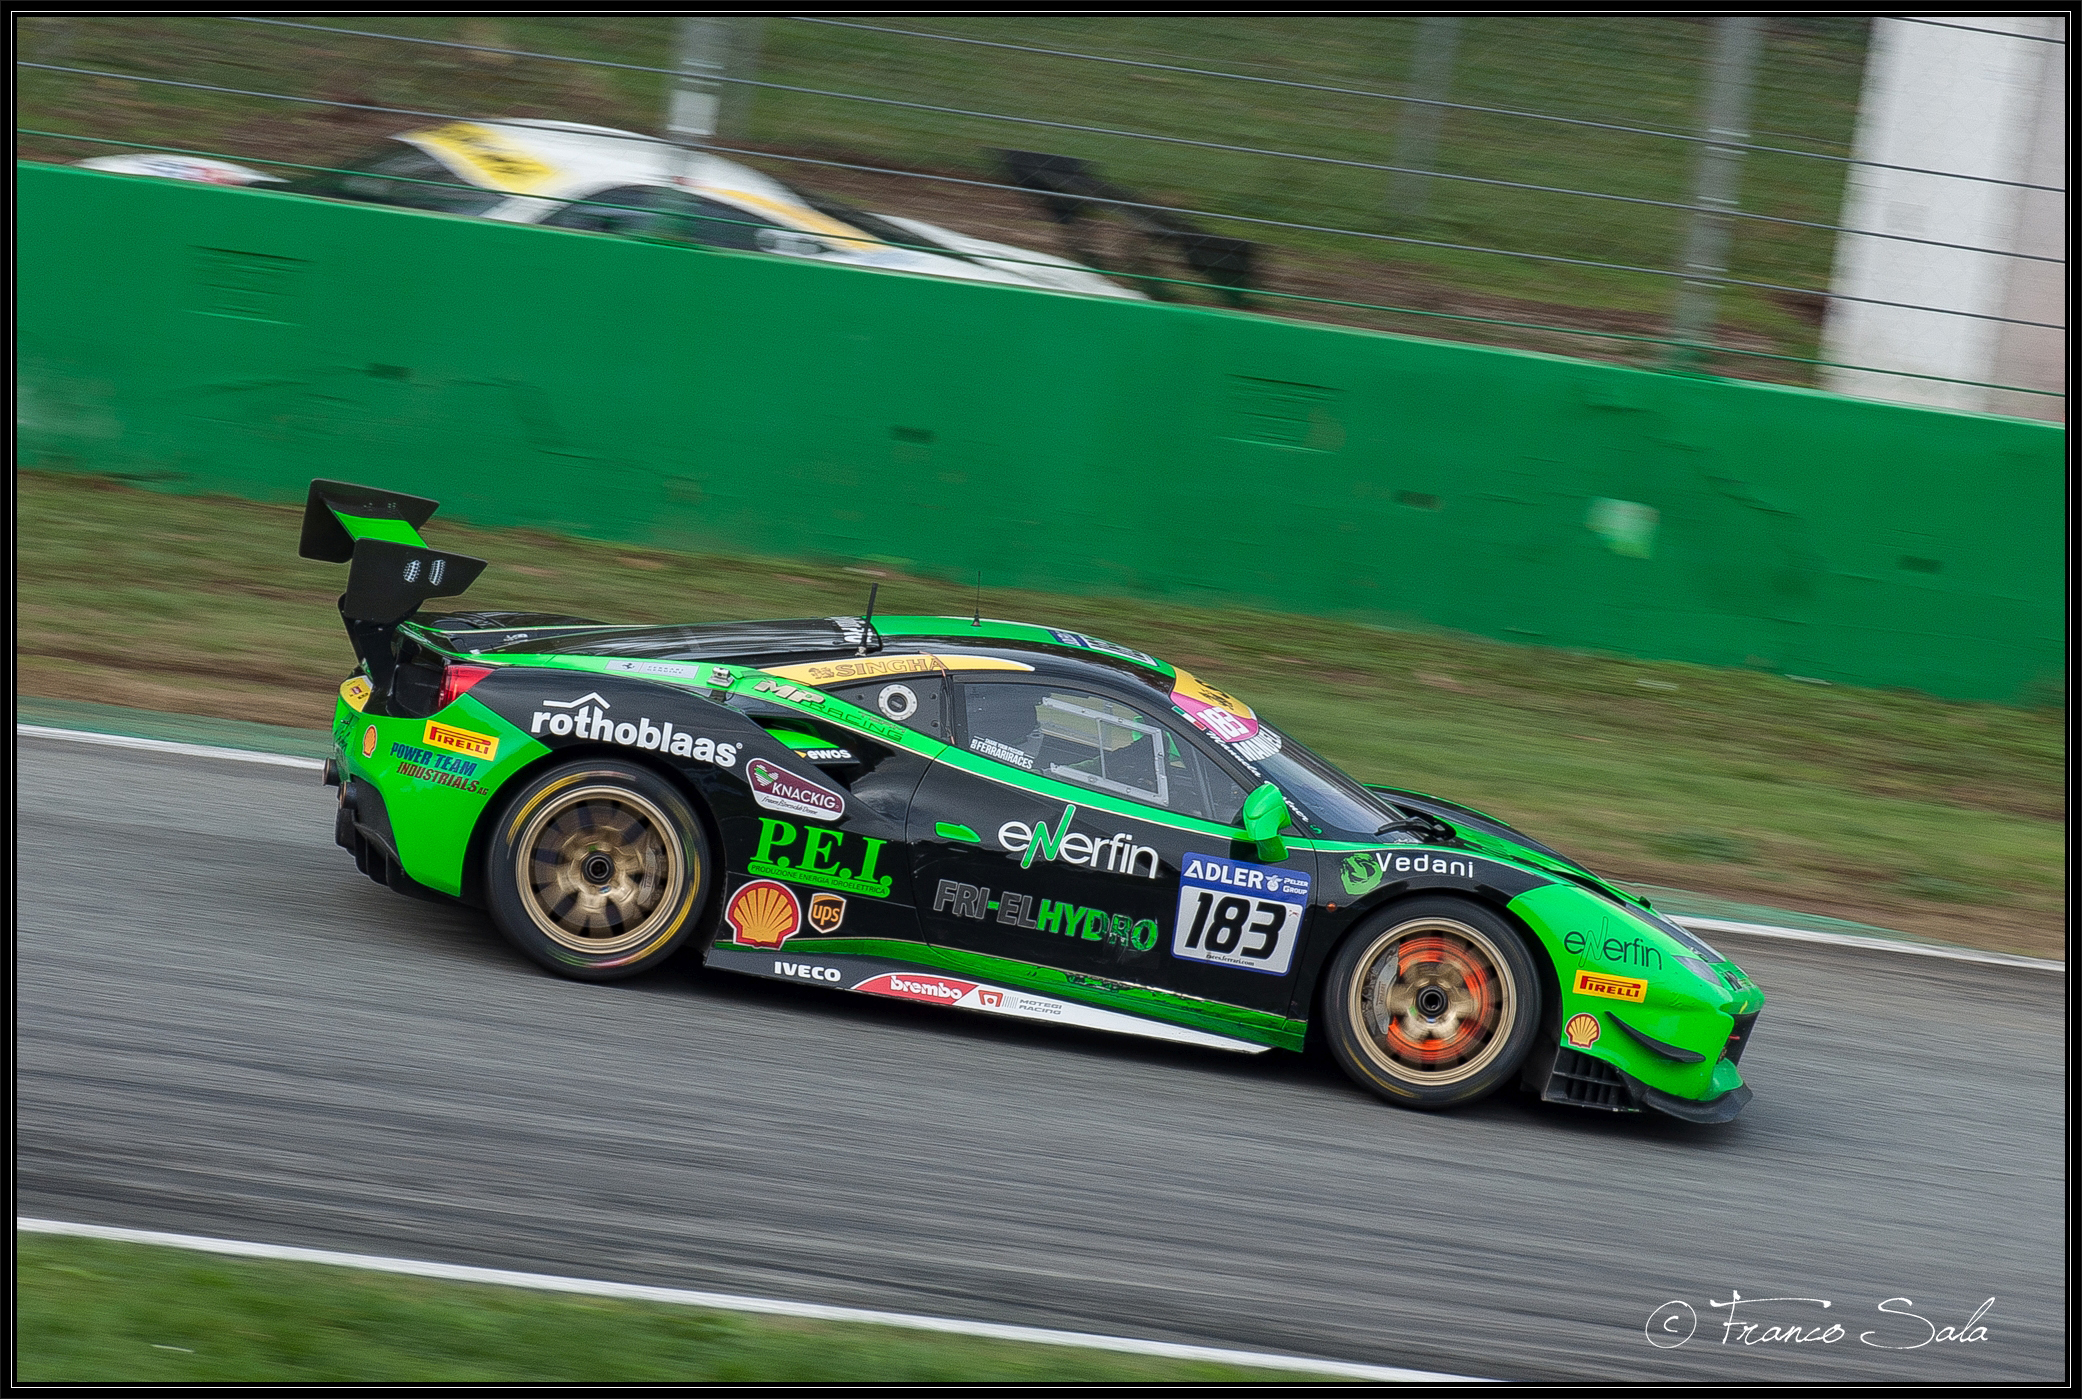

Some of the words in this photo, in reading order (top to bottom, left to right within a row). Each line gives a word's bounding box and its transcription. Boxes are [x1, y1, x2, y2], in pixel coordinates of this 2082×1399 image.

[834, 657, 946, 678] SINGHA
[754, 679, 825, 704] MP
[1196, 706, 1250, 741] 183
[429, 726, 492, 755] PIRELLI
[806, 749, 852, 759] ewos
[390, 742, 435, 766] POWER
[436, 753, 477, 777] TEAM
[976, 742, 1034, 770] FERRARIRACES
[396, 761, 480, 793] INDUSTRIALS
[476, 787, 489, 797] AG
[771, 782, 836, 809] KNACKIG
[750, 817, 893, 887] P.E.I.
[1375, 852, 1474, 879] Vedani
[751, 864, 798, 878] PRODUZIONE
[799, 873, 830, 885] ENERGIA
[831, 880, 886, 895] IDROELETTRICA
[1183, 859, 1265, 890] ADLER
[812, 904, 840, 926] ups
[1184, 891, 1287, 960] 183
[774, 961, 841, 982] IVECO
[890, 975, 963, 1000] brembo
[1580, 975, 1641, 998] PIRELLI
[1019, 1004, 1062, 1015] RACING
[1020, 999, 1063, 1009] MOTEGI
